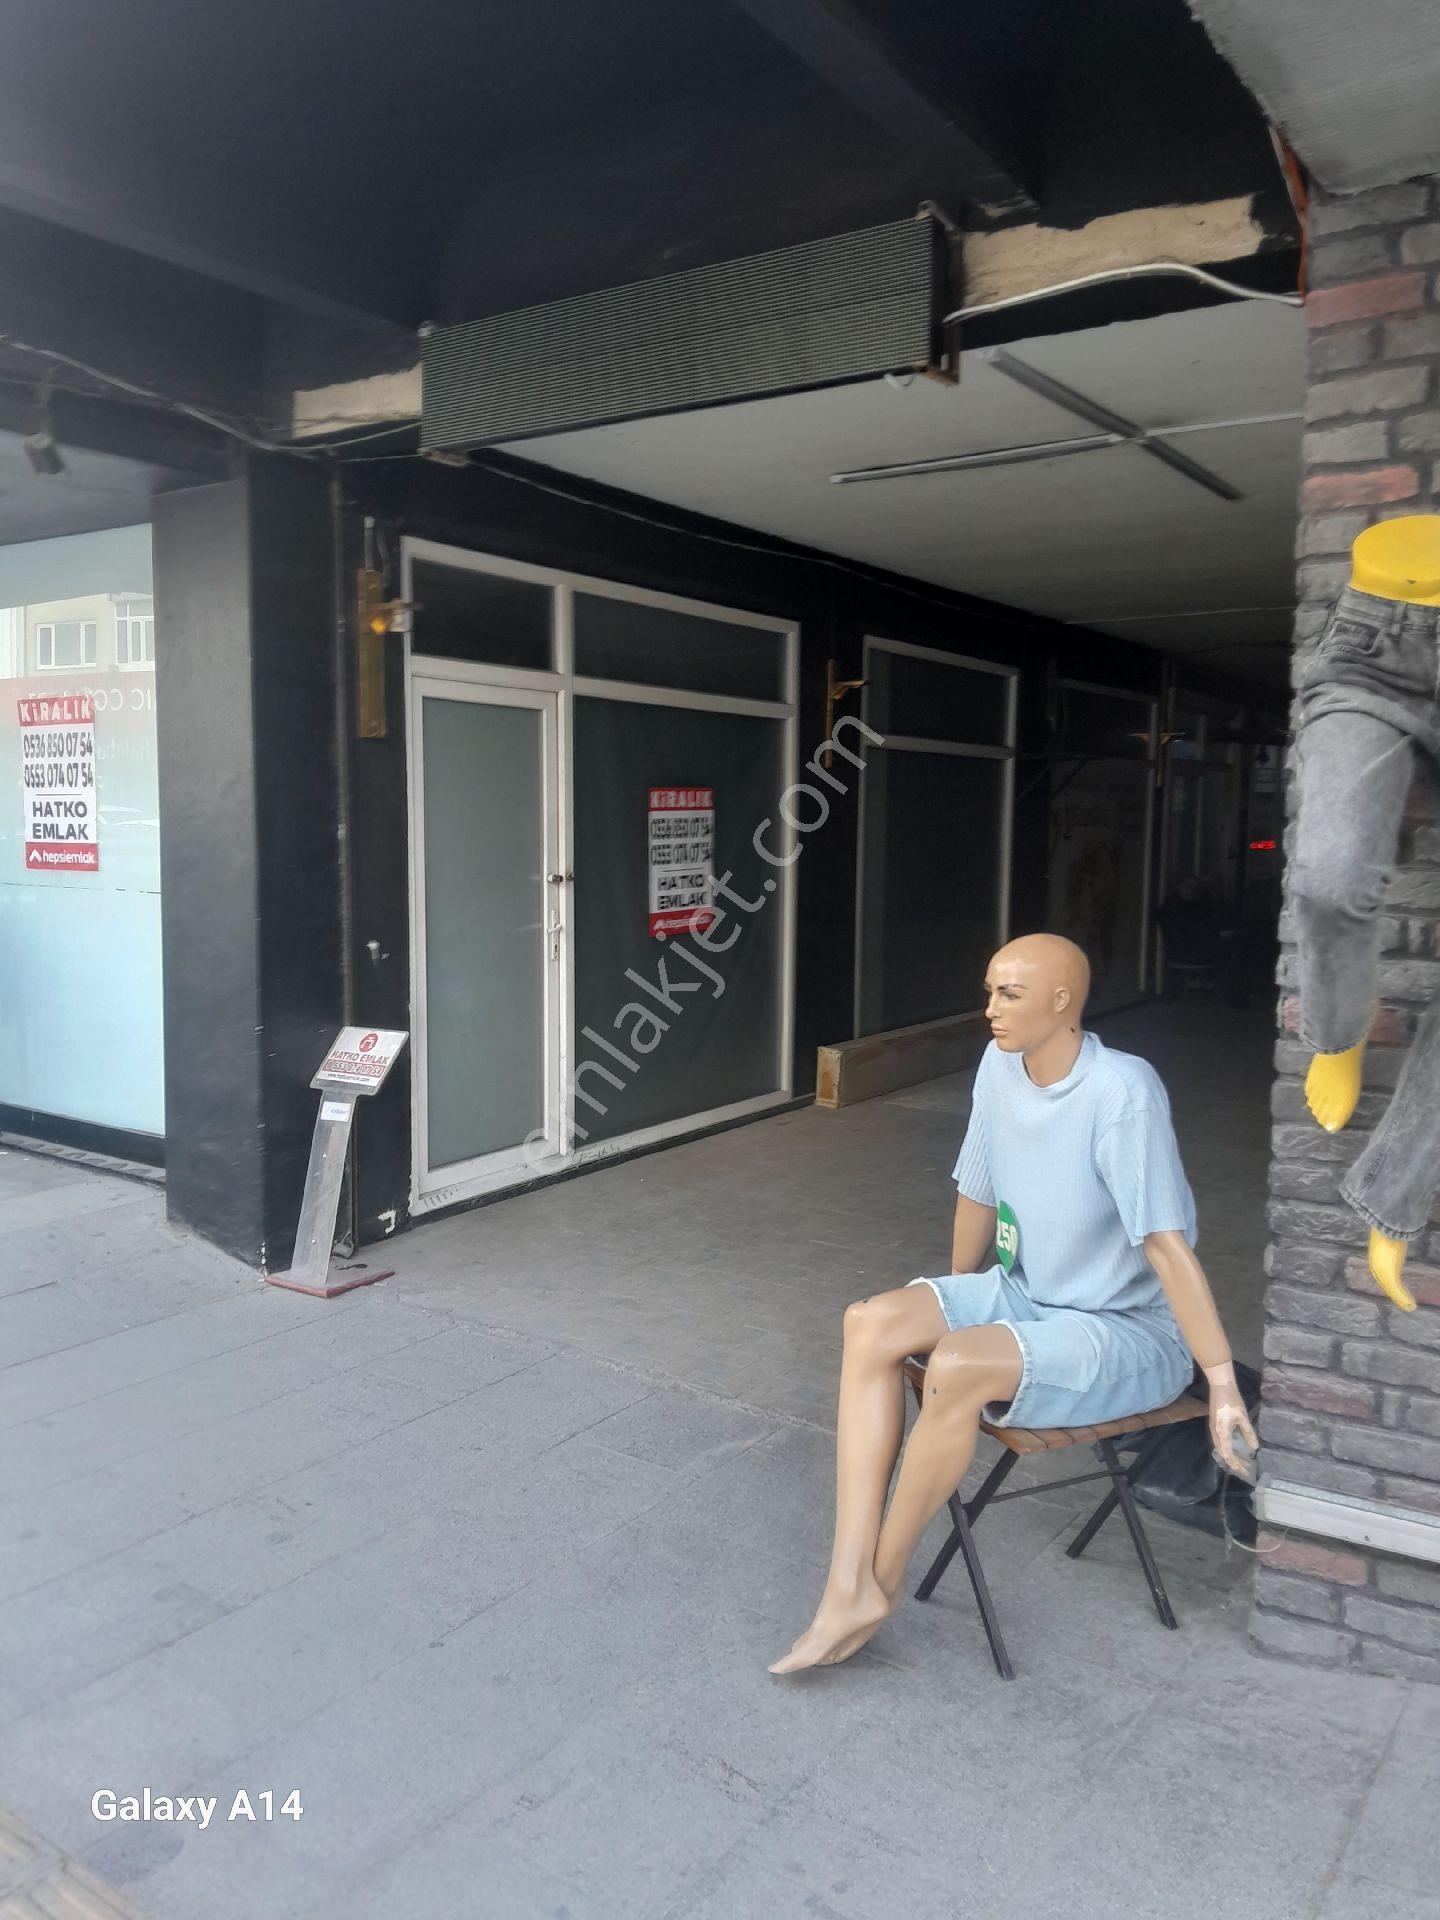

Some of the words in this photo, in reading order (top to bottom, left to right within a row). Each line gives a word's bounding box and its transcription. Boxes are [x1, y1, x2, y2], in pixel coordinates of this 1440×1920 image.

[24, 733, 45, 758] 0536
[66, 732, 78, 757] 07
[80, 732, 93, 757] 54
[24, 764, 45, 788] 0553
[47, 763, 64, 788] 074
[67, 763, 79, 788] 07
[81, 762, 94, 788] 54
[33, 801, 87, 818] HATKO
[32, 823, 89, 840] EMLAK
[43, 849, 95, 864] hepsiemlak
[657, 873, 704, 891] HATKO
[657, 892, 707, 910] EMLAK
[331, 1050, 359, 1062] HATKO
[360, 1054, 389, 1065] EMLAK
